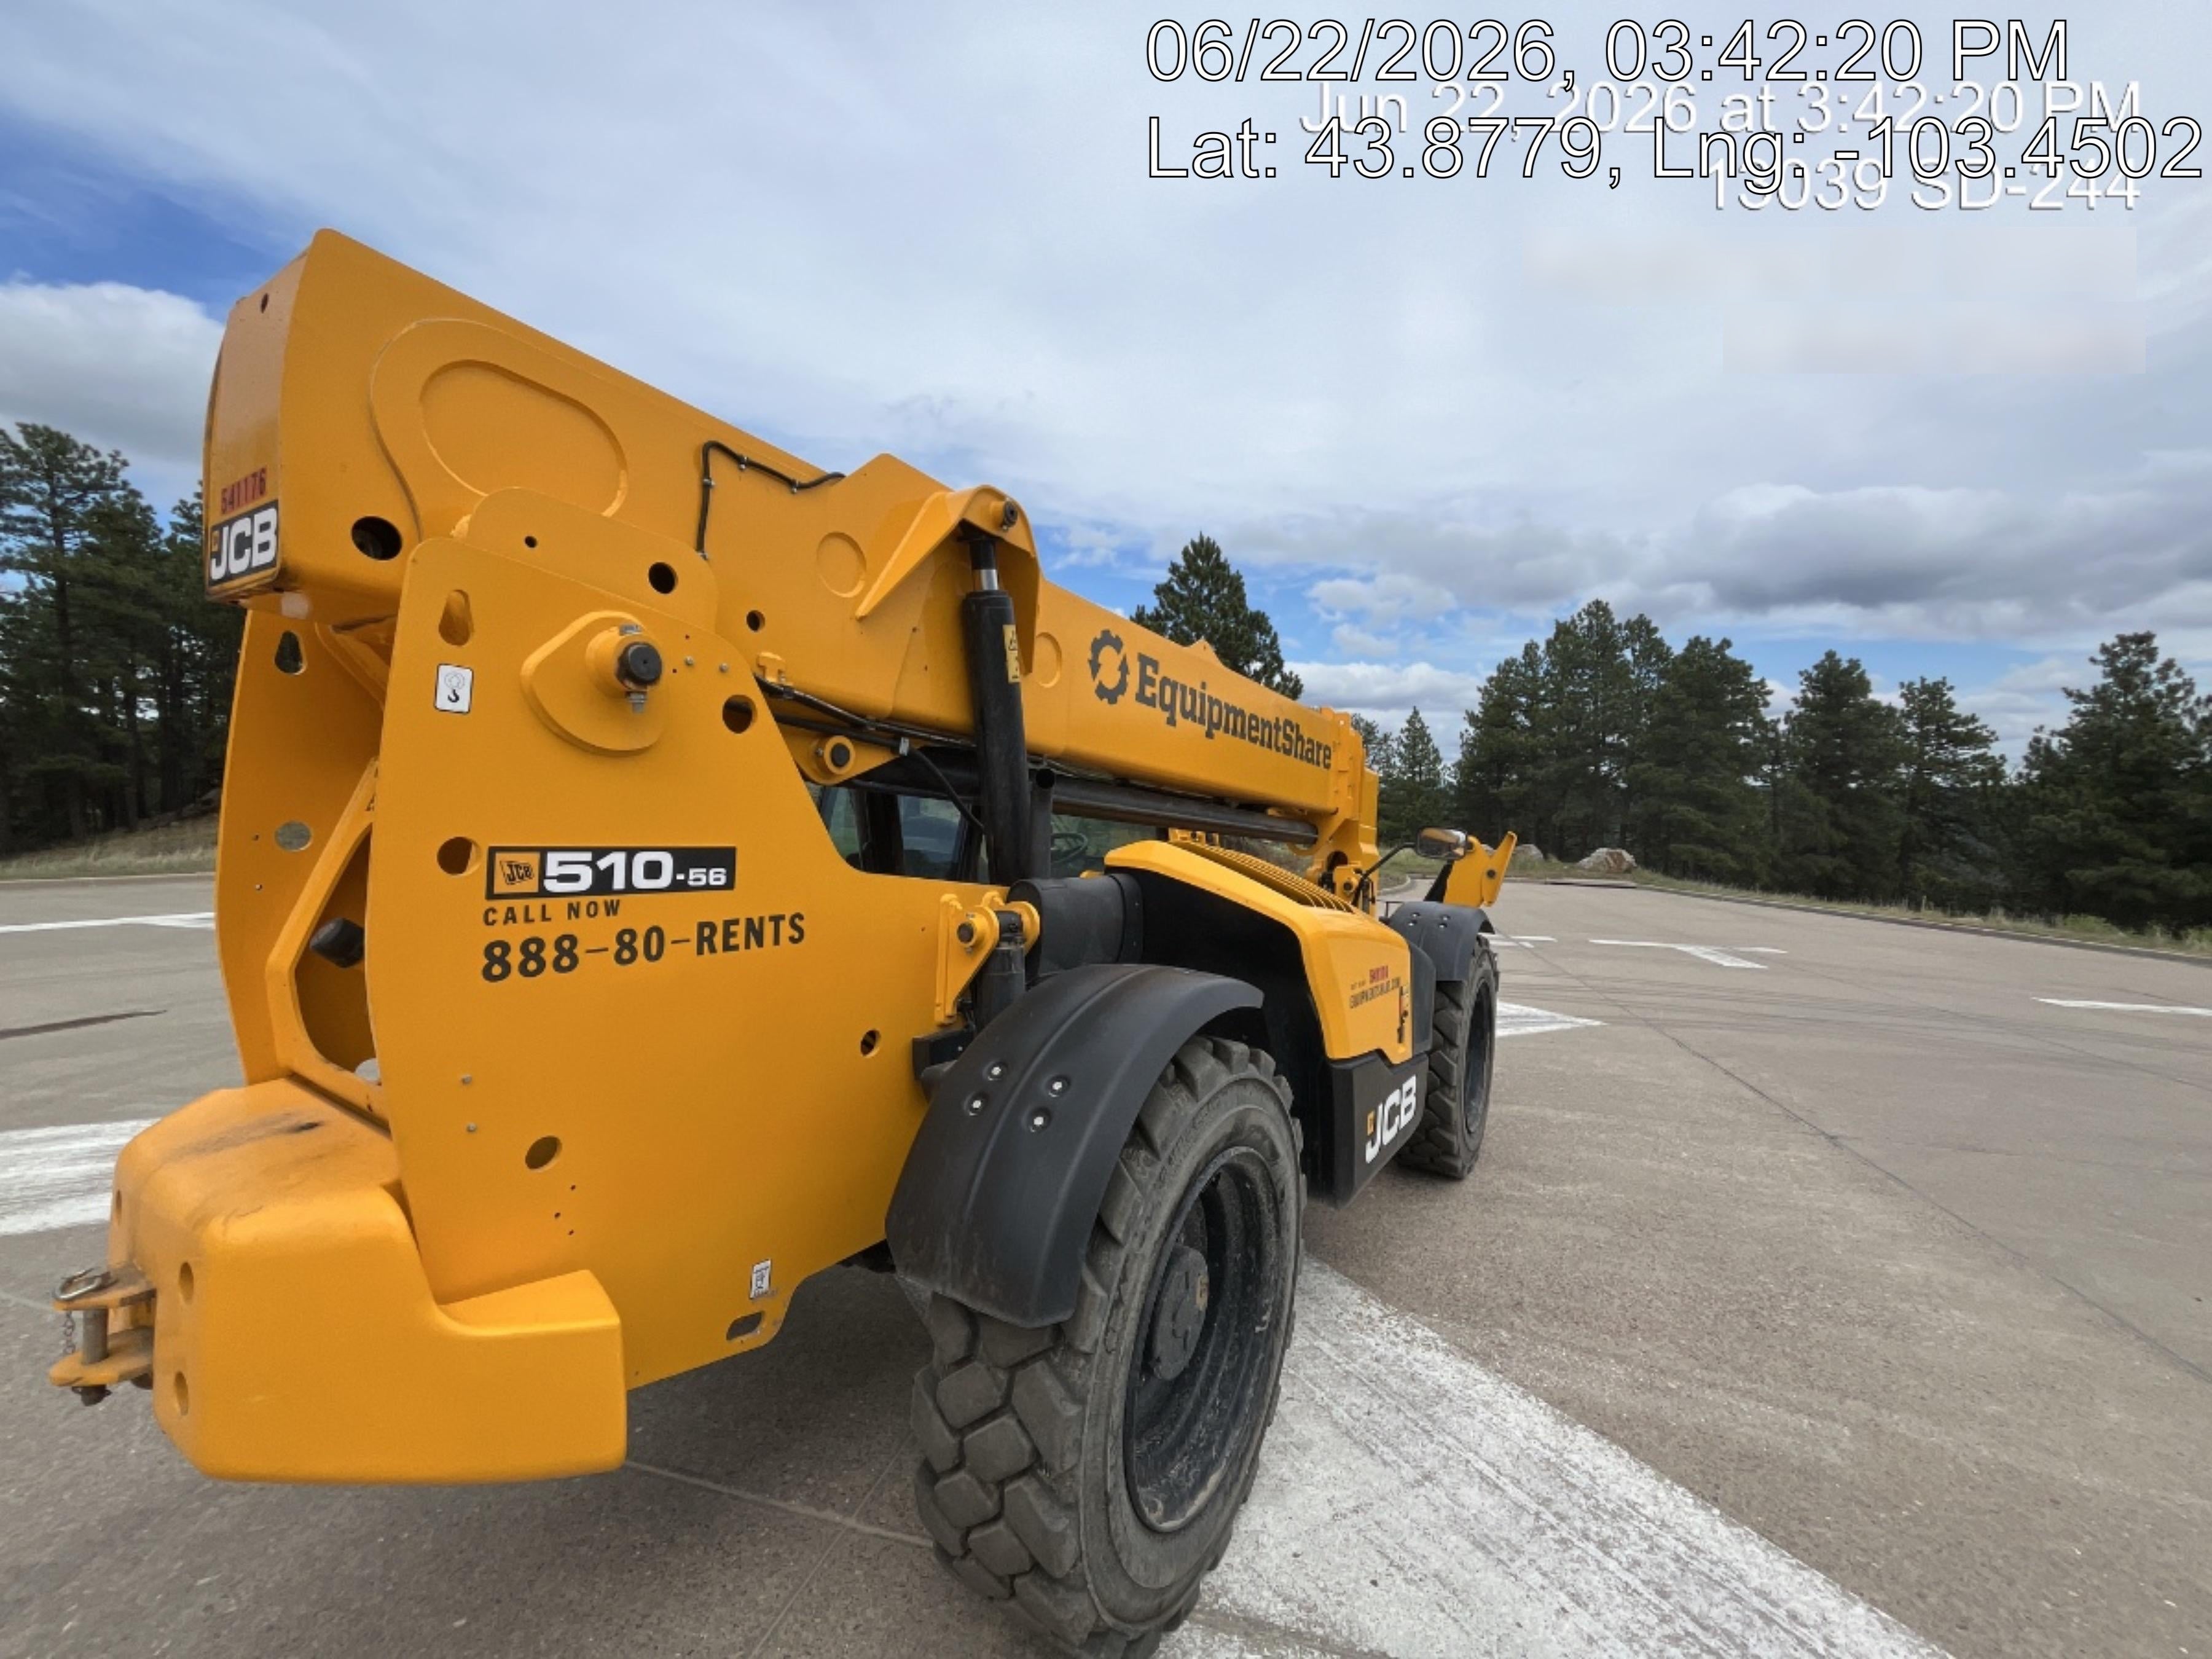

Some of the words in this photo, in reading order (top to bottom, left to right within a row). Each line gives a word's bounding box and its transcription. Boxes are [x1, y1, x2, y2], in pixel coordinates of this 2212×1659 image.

[210, 507, 278, 581] JCB
[1135, 652, 1332, 769] EquipmentShare
[503, 860, 535, 885] JCB
[543, 850, 728, 893] 510-56
[481, 912, 806, 983] 888-80-RENTS
[482, 903, 552, 927] CALL
[567, 899, 621, 920] NOW
[1365, 1074, 1416, 1164] JCB
